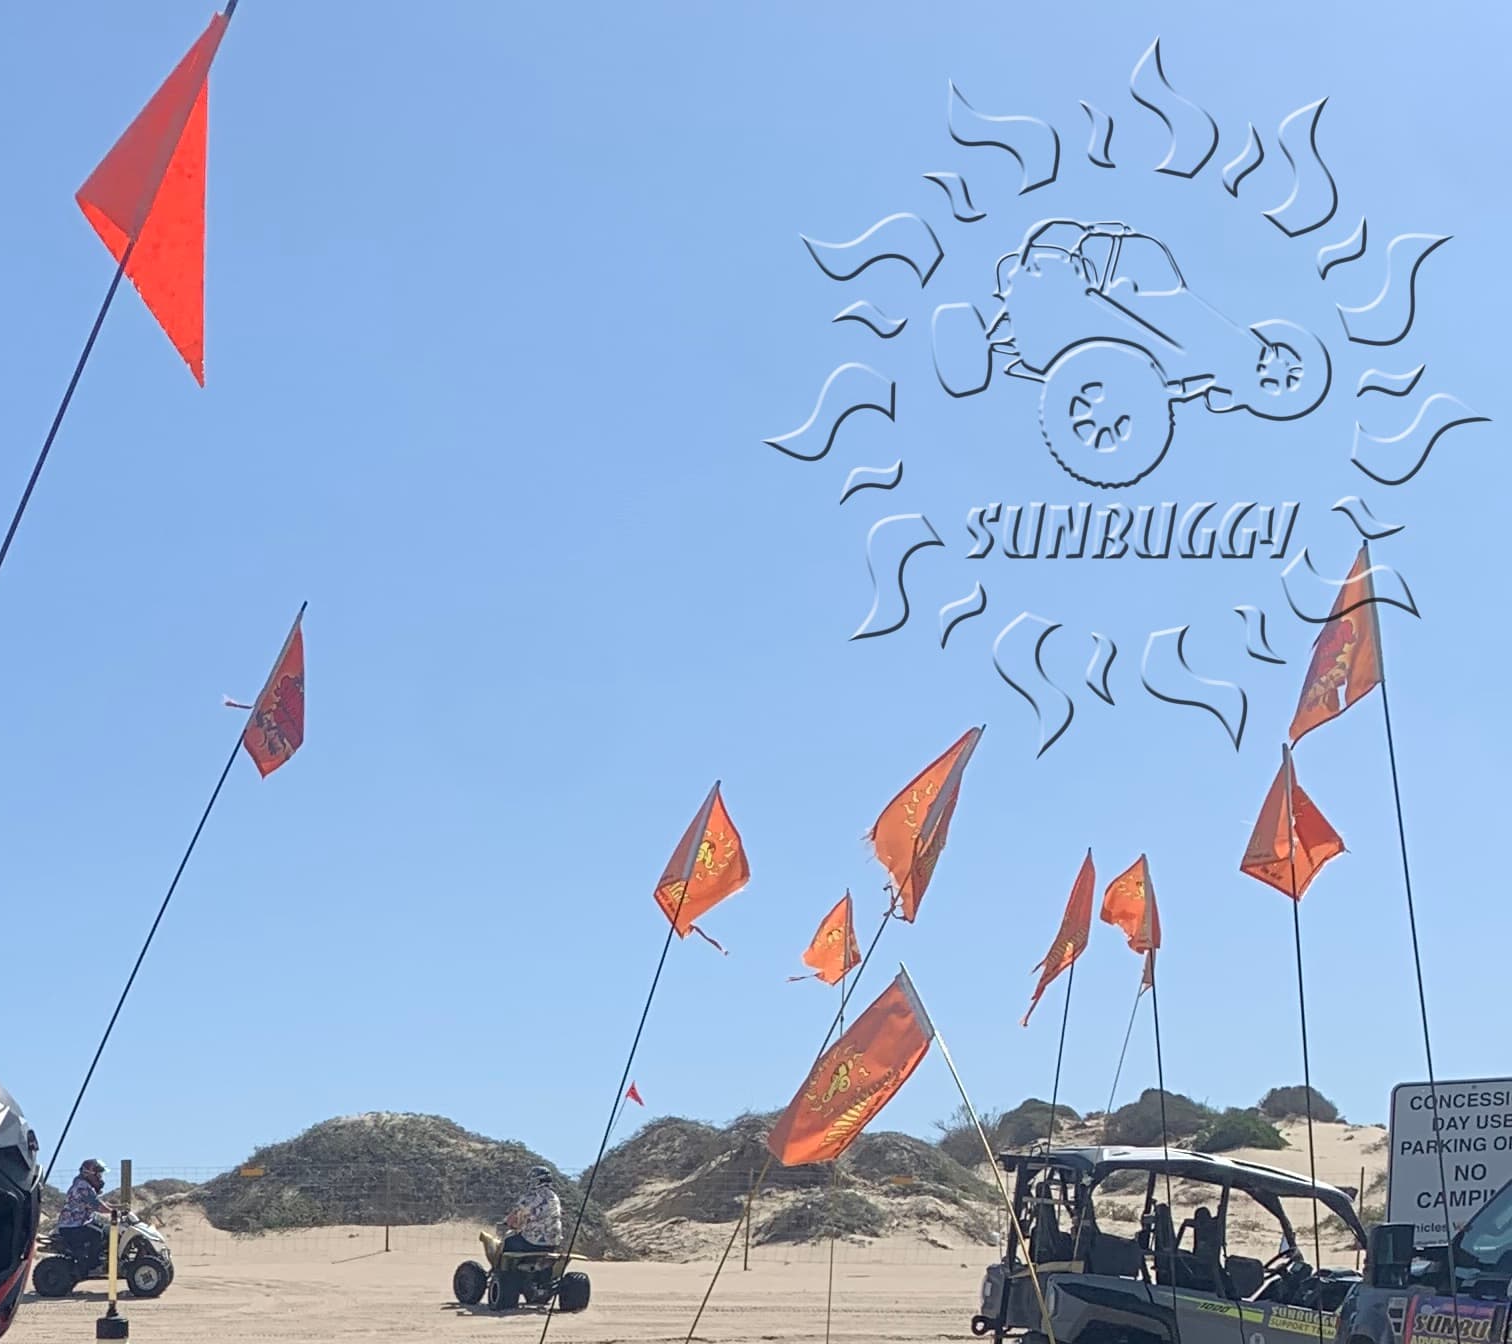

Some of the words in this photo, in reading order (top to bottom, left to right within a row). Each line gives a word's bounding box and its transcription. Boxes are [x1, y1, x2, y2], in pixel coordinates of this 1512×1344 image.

[1410, 1091, 1512, 1110] CONCESSI
[1432, 1115, 1470, 1131] DAY
[1476, 1113, 1512, 1129] USE
[1400, 1136, 1487, 1155] PARKING
[1454, 1163, 1487, 1181] NO
[1416, 1188, 1496, 1208] CAMPI
